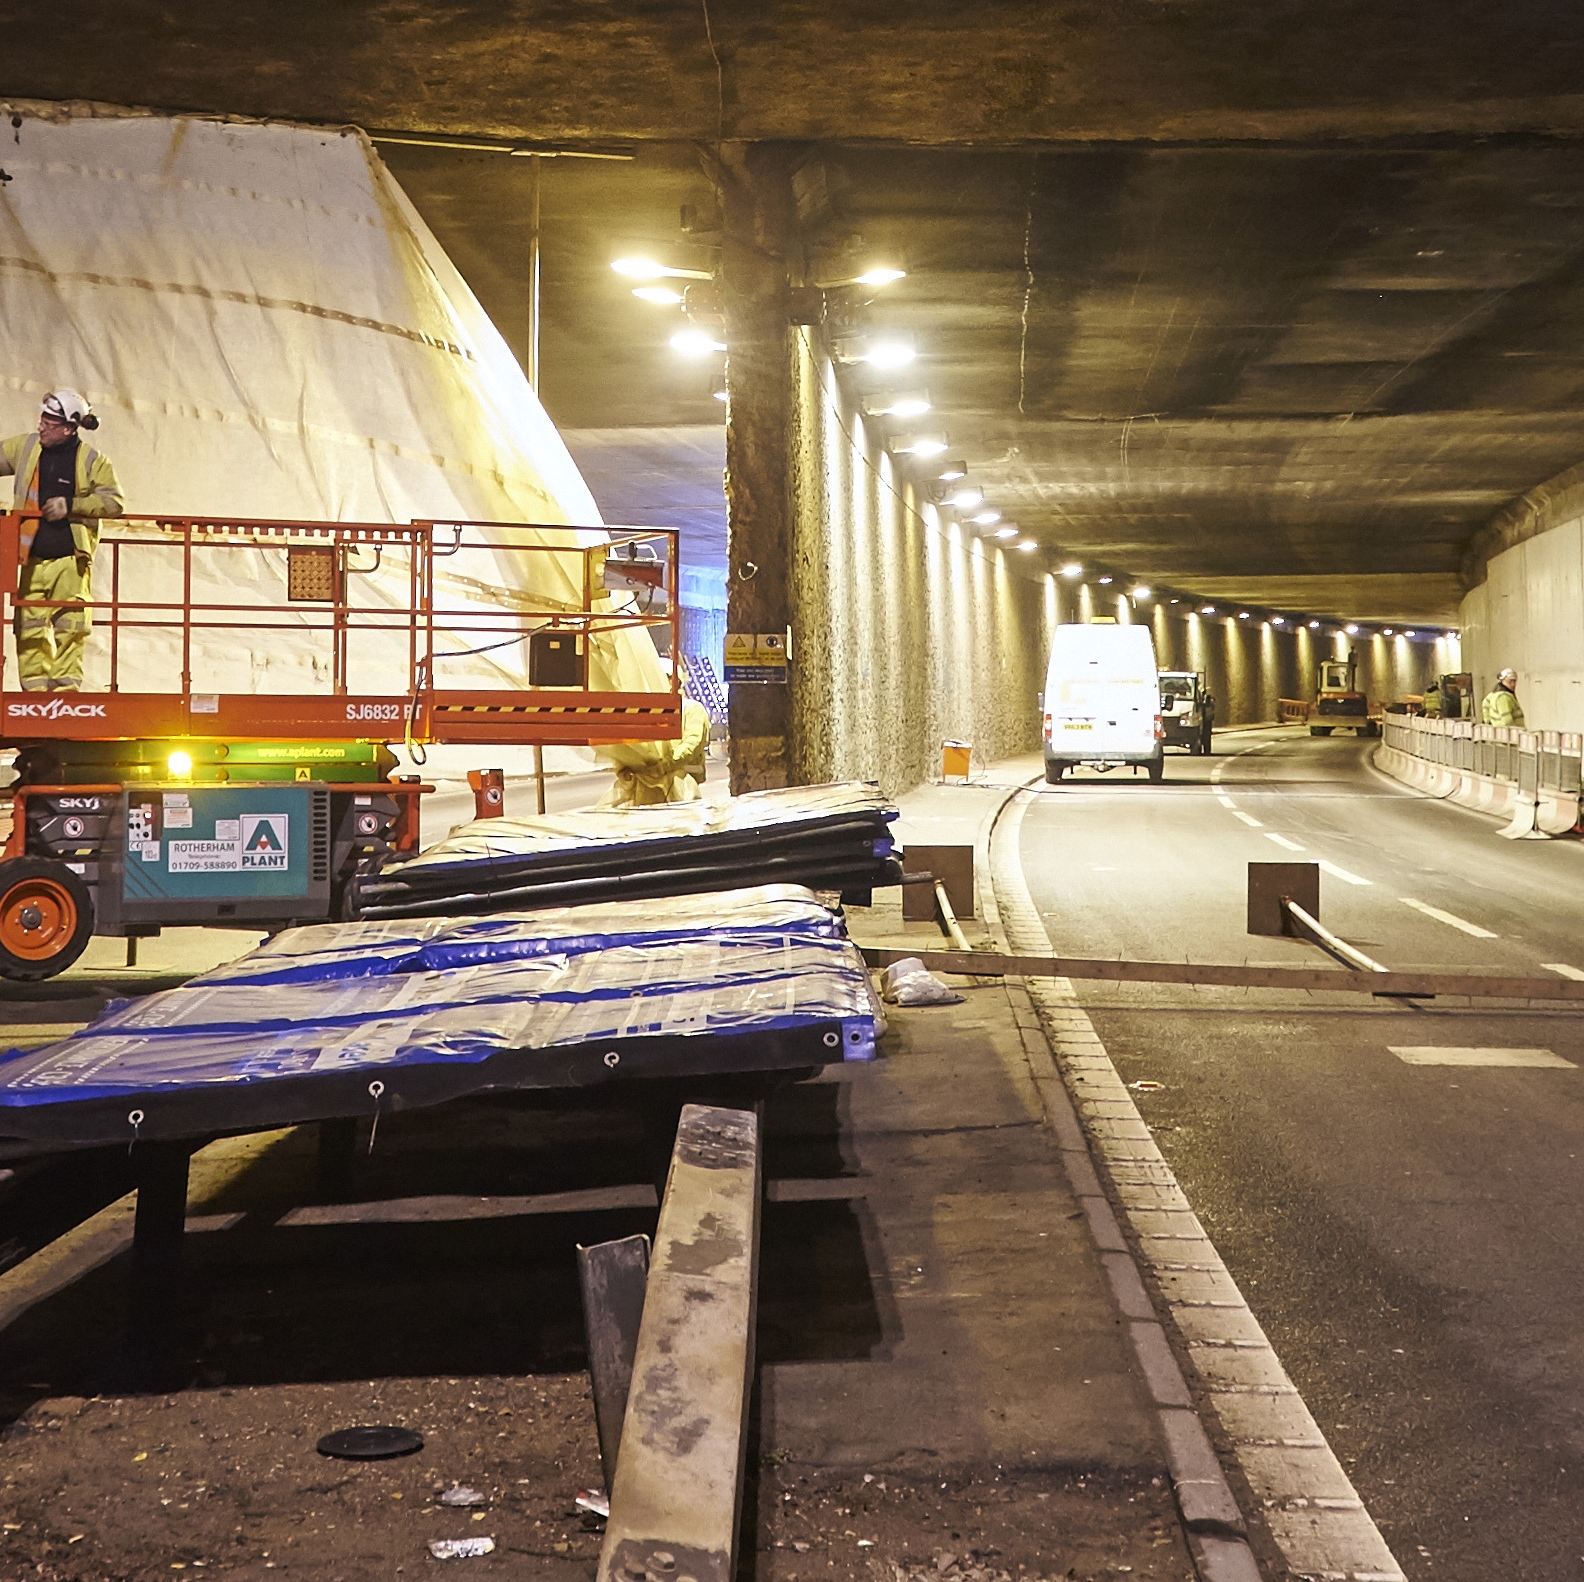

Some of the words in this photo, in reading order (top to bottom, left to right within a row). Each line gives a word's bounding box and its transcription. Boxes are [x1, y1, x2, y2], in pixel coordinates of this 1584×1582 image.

[7, 698, 107, 720] SKYJACK
[346, 703, 400, 720] SJ6832
[256, 746, 346, 759] www.aplant.com
[244, 819, 284, 851] A
[173, 842, 235, 853] ROTHERHAM
[241, 855, 286, 867] PLANT
